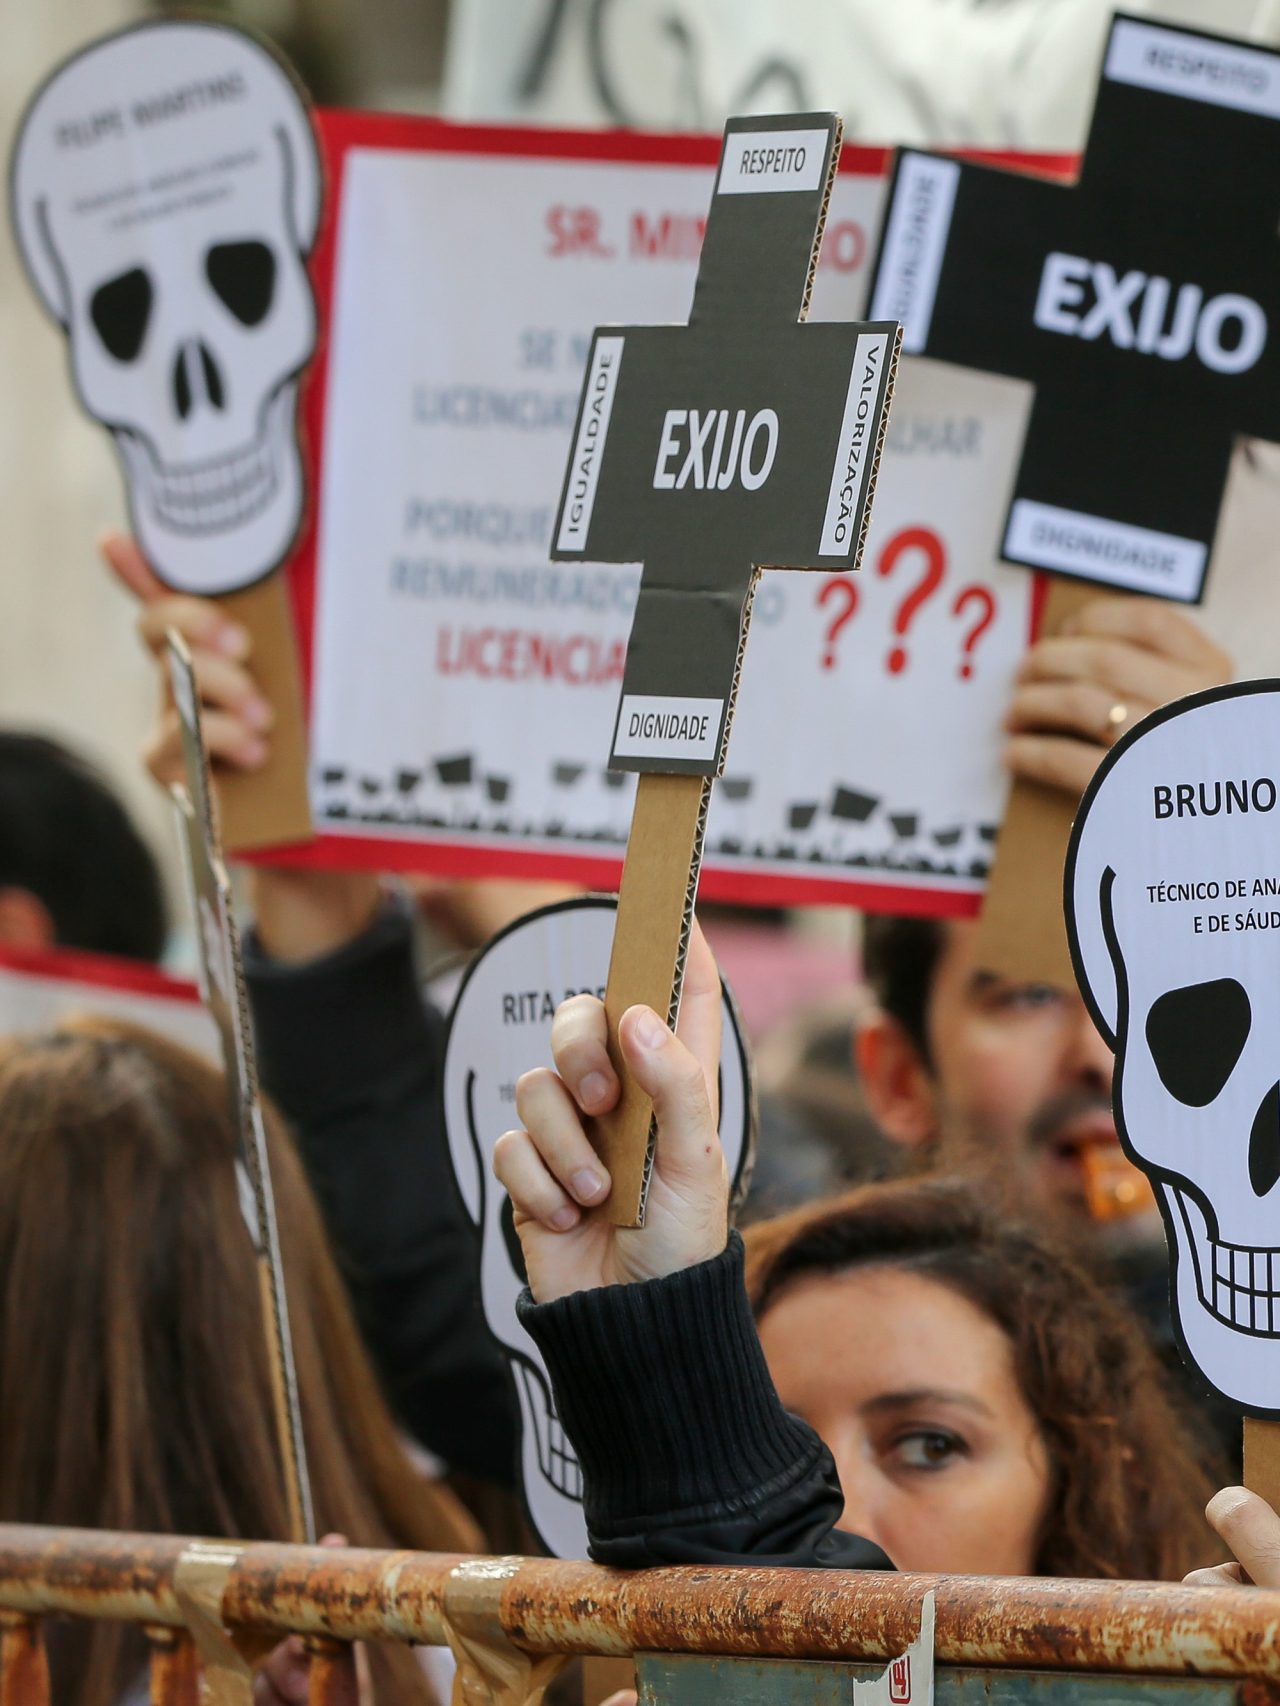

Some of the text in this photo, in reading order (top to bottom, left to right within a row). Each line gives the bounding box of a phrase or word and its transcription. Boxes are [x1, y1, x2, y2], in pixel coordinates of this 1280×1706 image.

[1145, 44, 1270, 95] RESPEITO
[739, 147, 807, 175] RESPEITO
[545, 205, 616, 262] SR.
[1034, 251, 1267, 375] EXIJO
[568, 353, 613, 533] IGUALDADE
[653, 408, 779, 491] EXIJO
[834, 345, 880, 543] VALORIZAÇÃO
[628, 711, 708, 742] DIGNIDADE
[1154, 778, 1277, 819] BRUNO
[1146, 880, 1220, 904] TÉCNICO
[1225, 879, 1247, 899] DE
[1193, 916, 1203, 933] E
[1208, 913, 1230, 932] DE
[503, 990, 555, 1024] RITA
